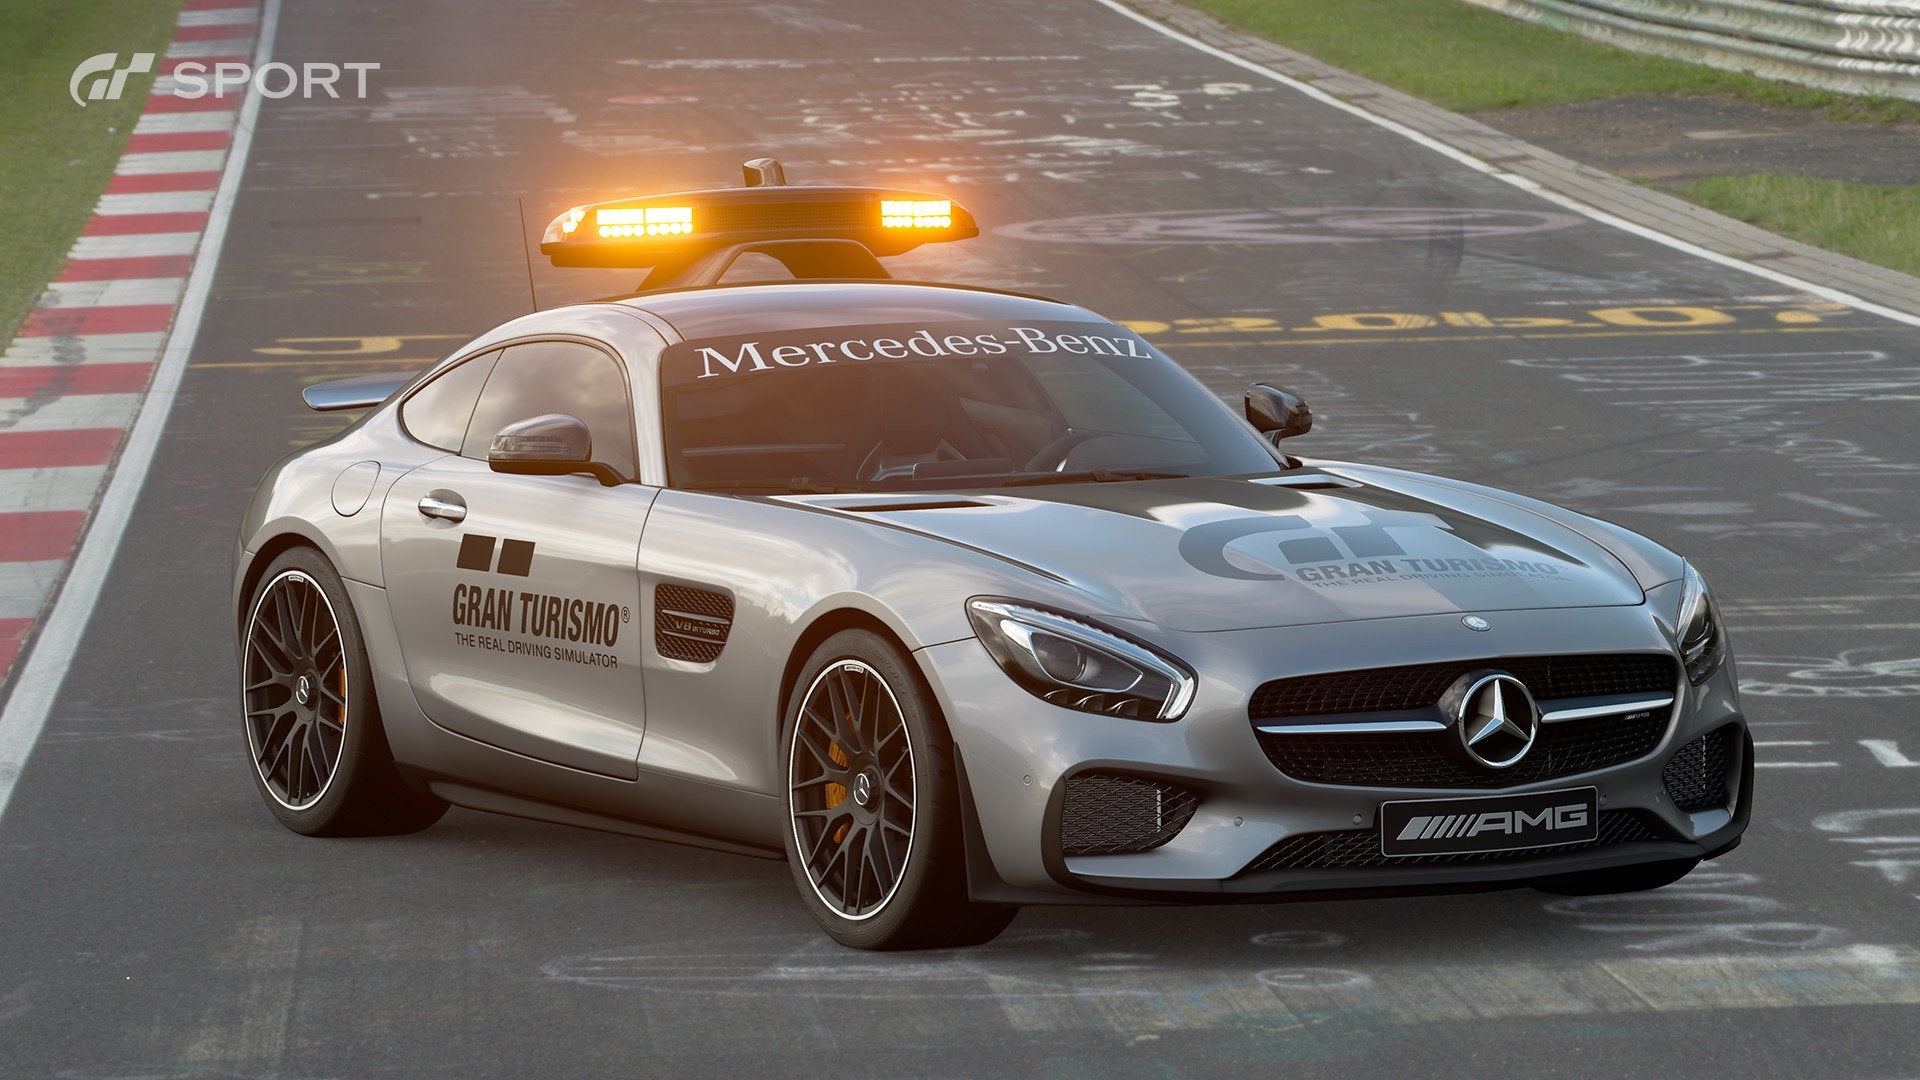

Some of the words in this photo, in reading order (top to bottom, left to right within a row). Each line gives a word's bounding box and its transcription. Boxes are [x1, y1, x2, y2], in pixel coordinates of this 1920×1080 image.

[694, 326, 1153, 379] Mercedes-Benz
[1296, 559, 1397, 582] GRAN
[1400, 558, 1558, 576] TURISMO
[1314, 579, 1349, 588] THE
[1352, 574, 1399, 585] REAL
[1400, 571, 1470, 582] DRIVING
[1473, 569, 1571, 583] SIMULATOR
[452, 583, 514, 631] GRAN
[455, 632, 475, 648] THE
[479, 635, 505, 652] REAL
[508, 640, 551, 659] DRIVING
[554, 646, 618, 669] SIMULATOR
[1466, 803, 1588, 838] AMG
